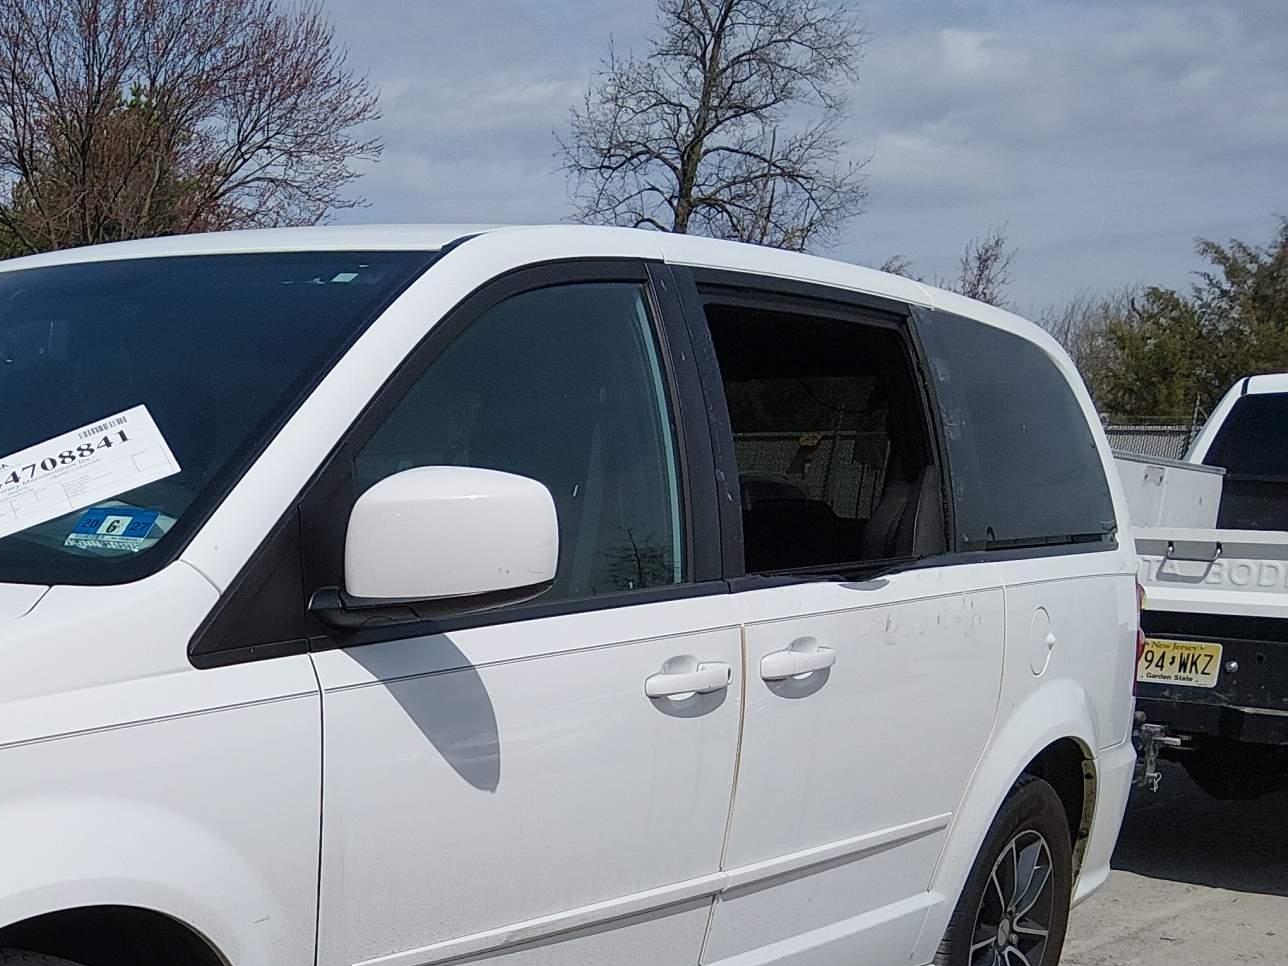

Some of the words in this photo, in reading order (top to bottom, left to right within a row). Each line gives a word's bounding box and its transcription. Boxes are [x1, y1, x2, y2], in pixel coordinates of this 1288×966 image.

[1151, 641, 1171, 649] New
[1171, 642, 1197, 652] Jersey
[1146, 672, 1172, 680] Garden
[1174, 674, 1193, 682] State
